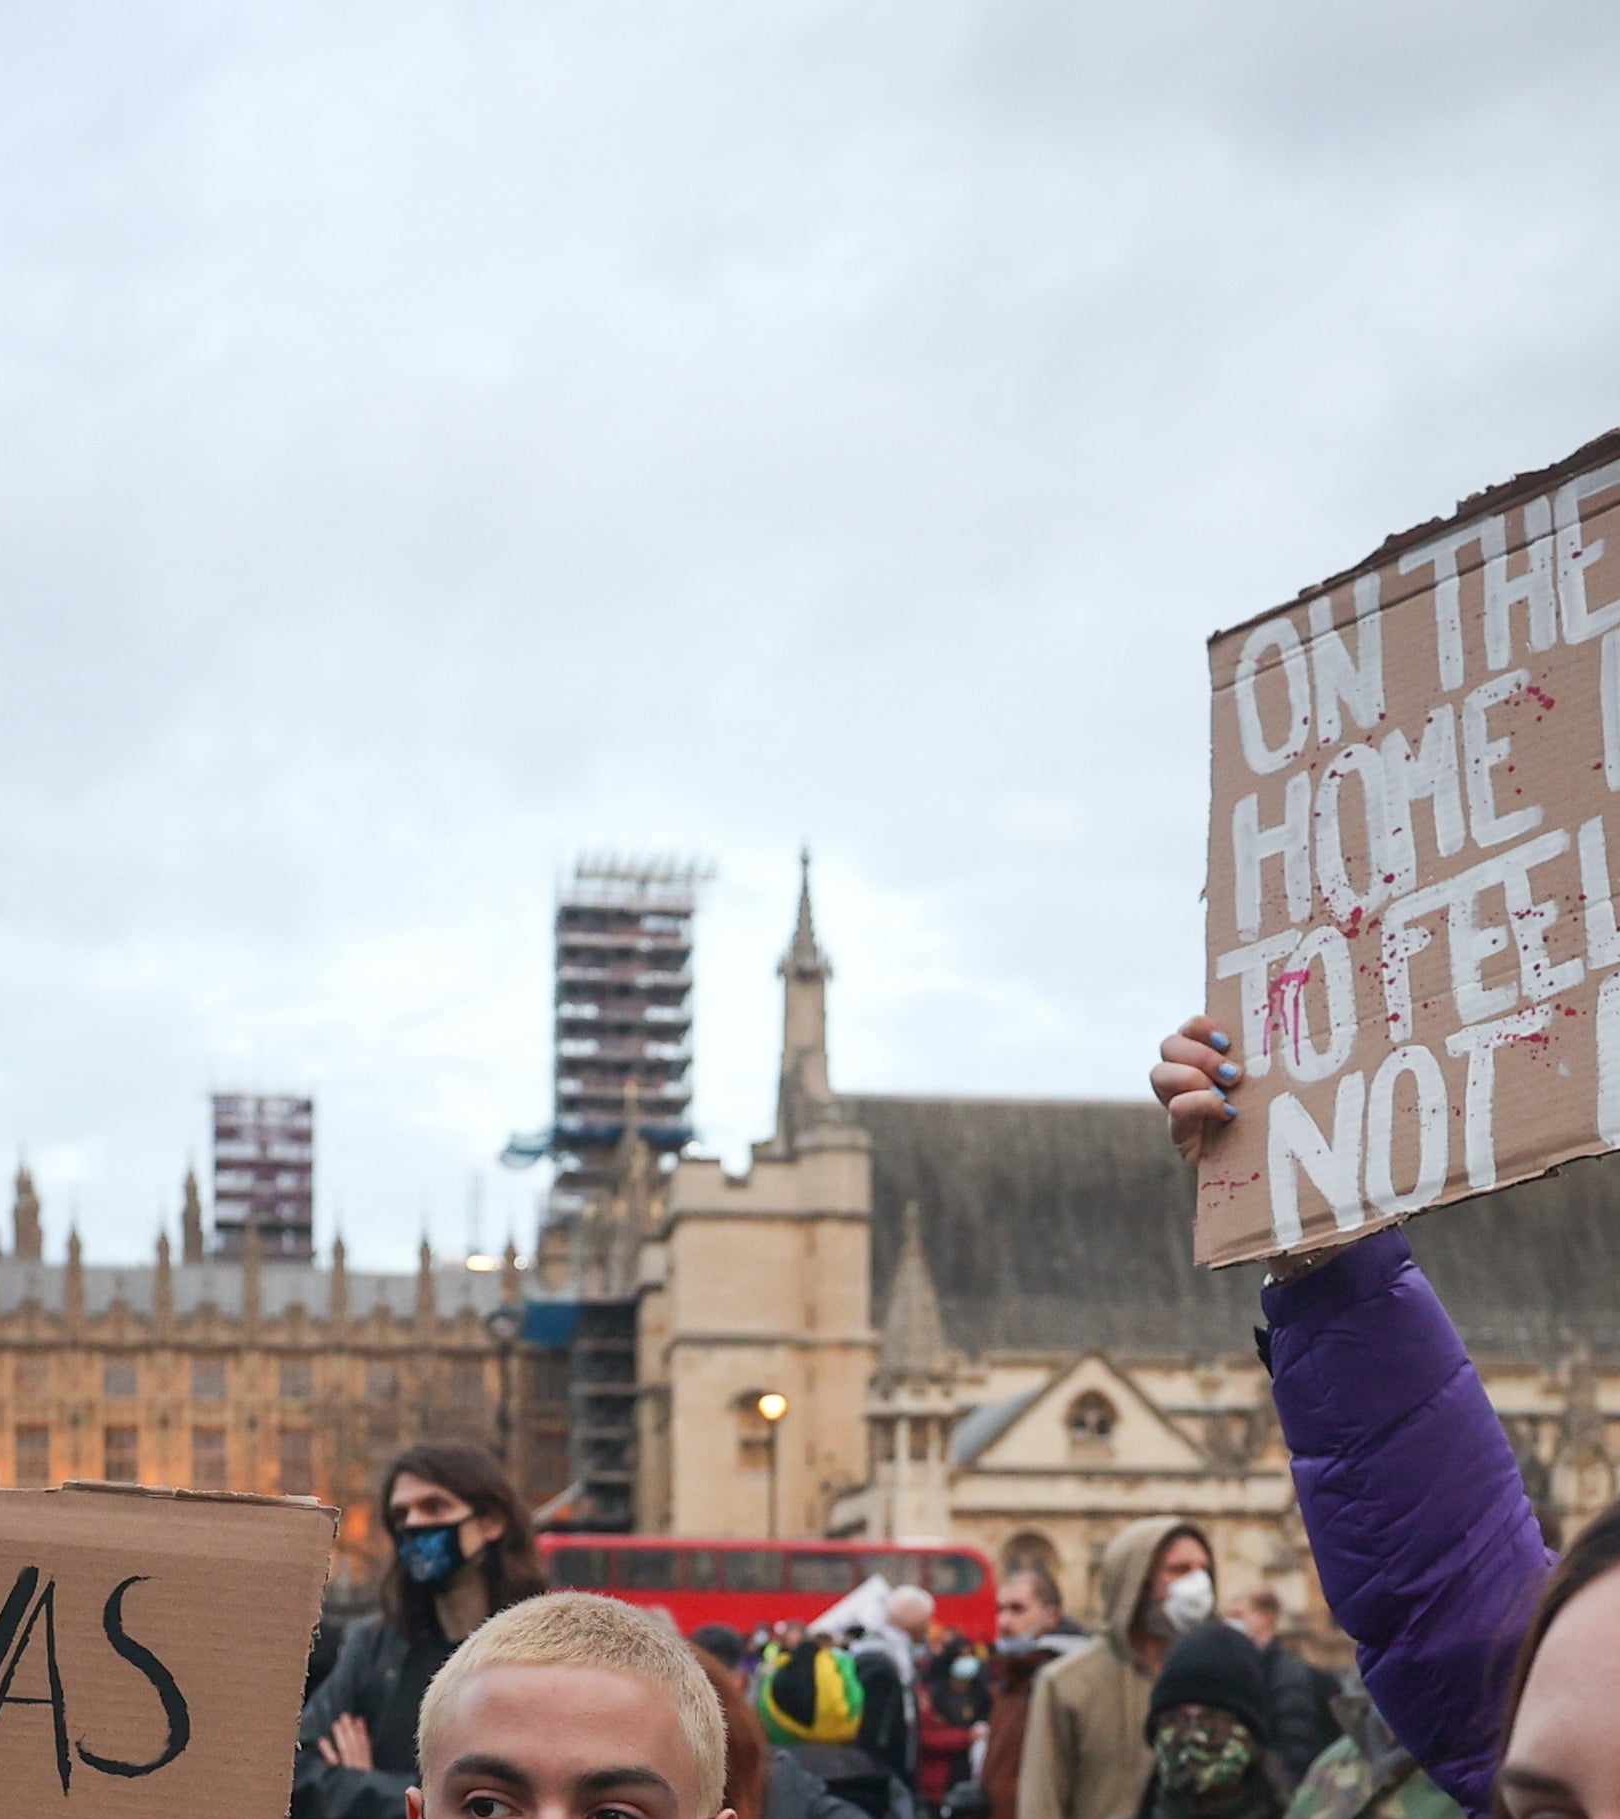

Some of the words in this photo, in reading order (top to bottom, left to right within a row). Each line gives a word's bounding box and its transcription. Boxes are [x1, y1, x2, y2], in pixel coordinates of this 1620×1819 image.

[1235, 574, 1386, 775] ON
[1232, 669, 1543, 941] HOME
[1216, 929, 1356, 1083] TO
[1265, 1006, 1552, 1251] NOT
